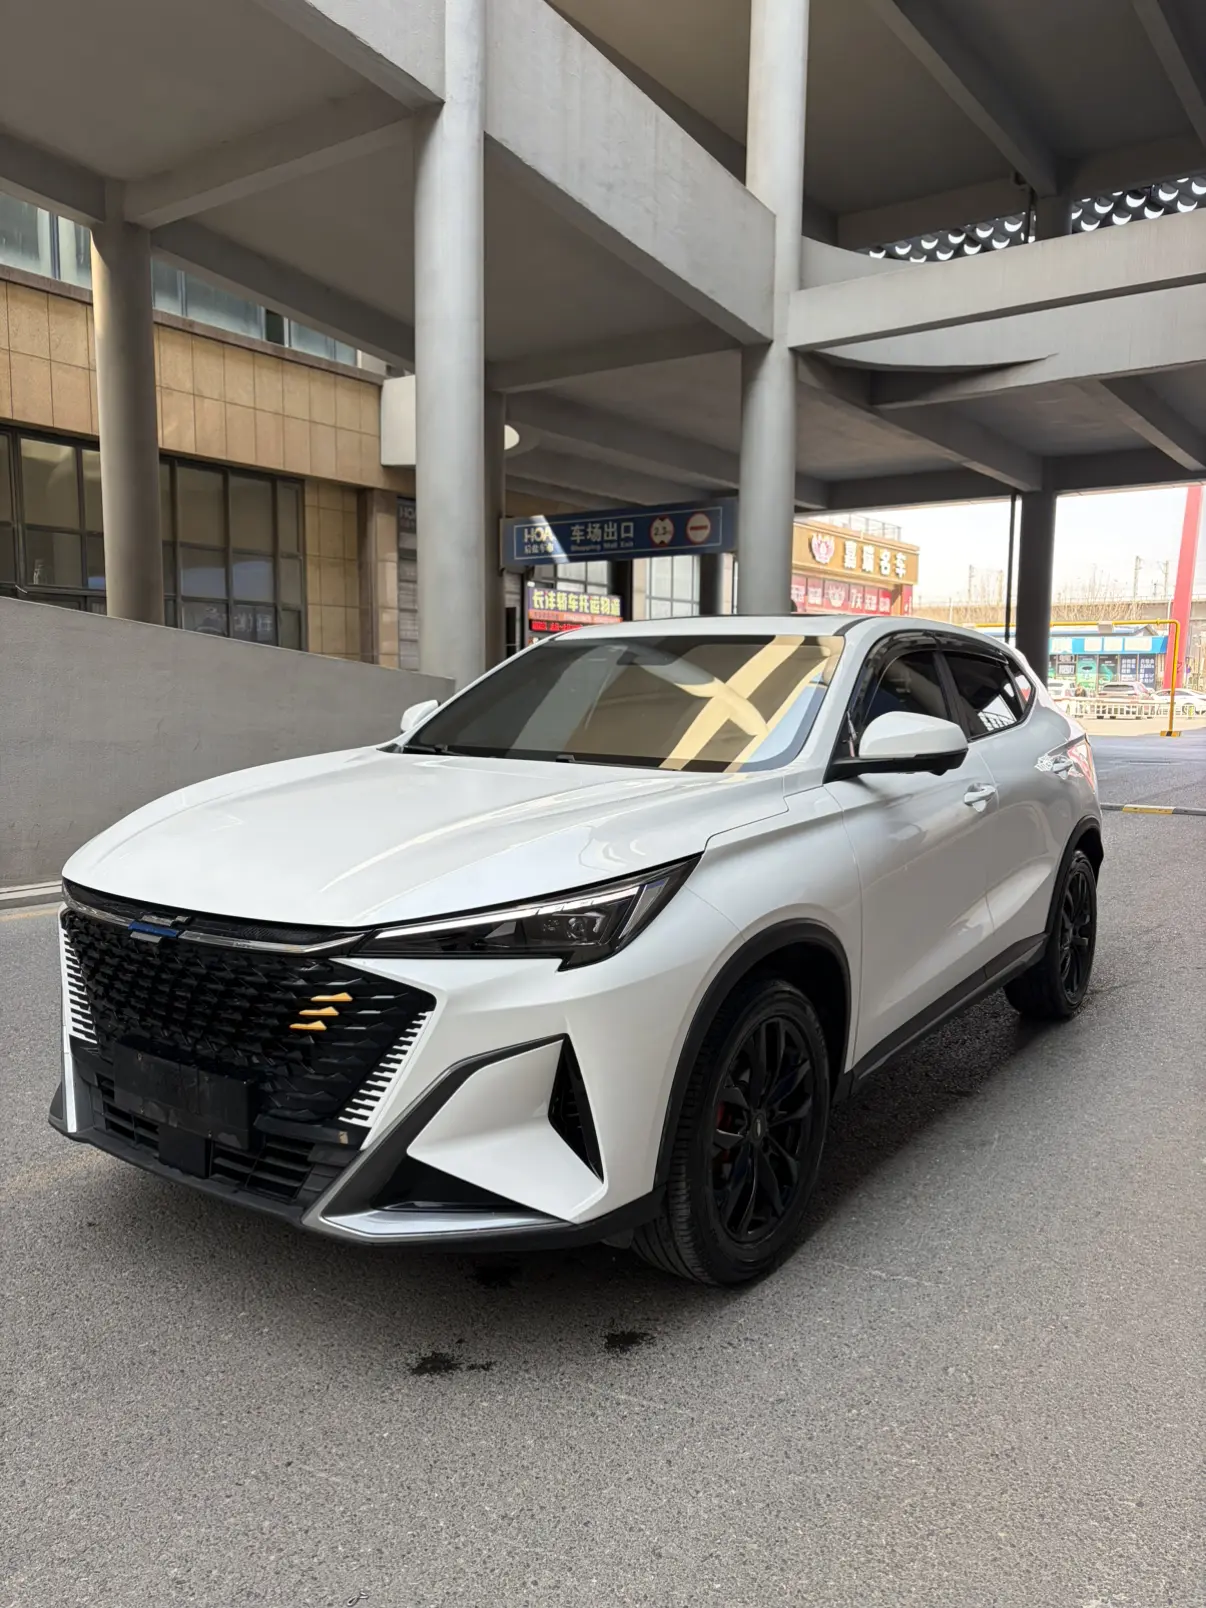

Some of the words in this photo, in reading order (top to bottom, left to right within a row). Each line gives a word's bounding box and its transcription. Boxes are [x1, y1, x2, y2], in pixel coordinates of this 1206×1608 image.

[523, 527, 553, 543] HOA
[570, 521, 635, 544] 车场出口
